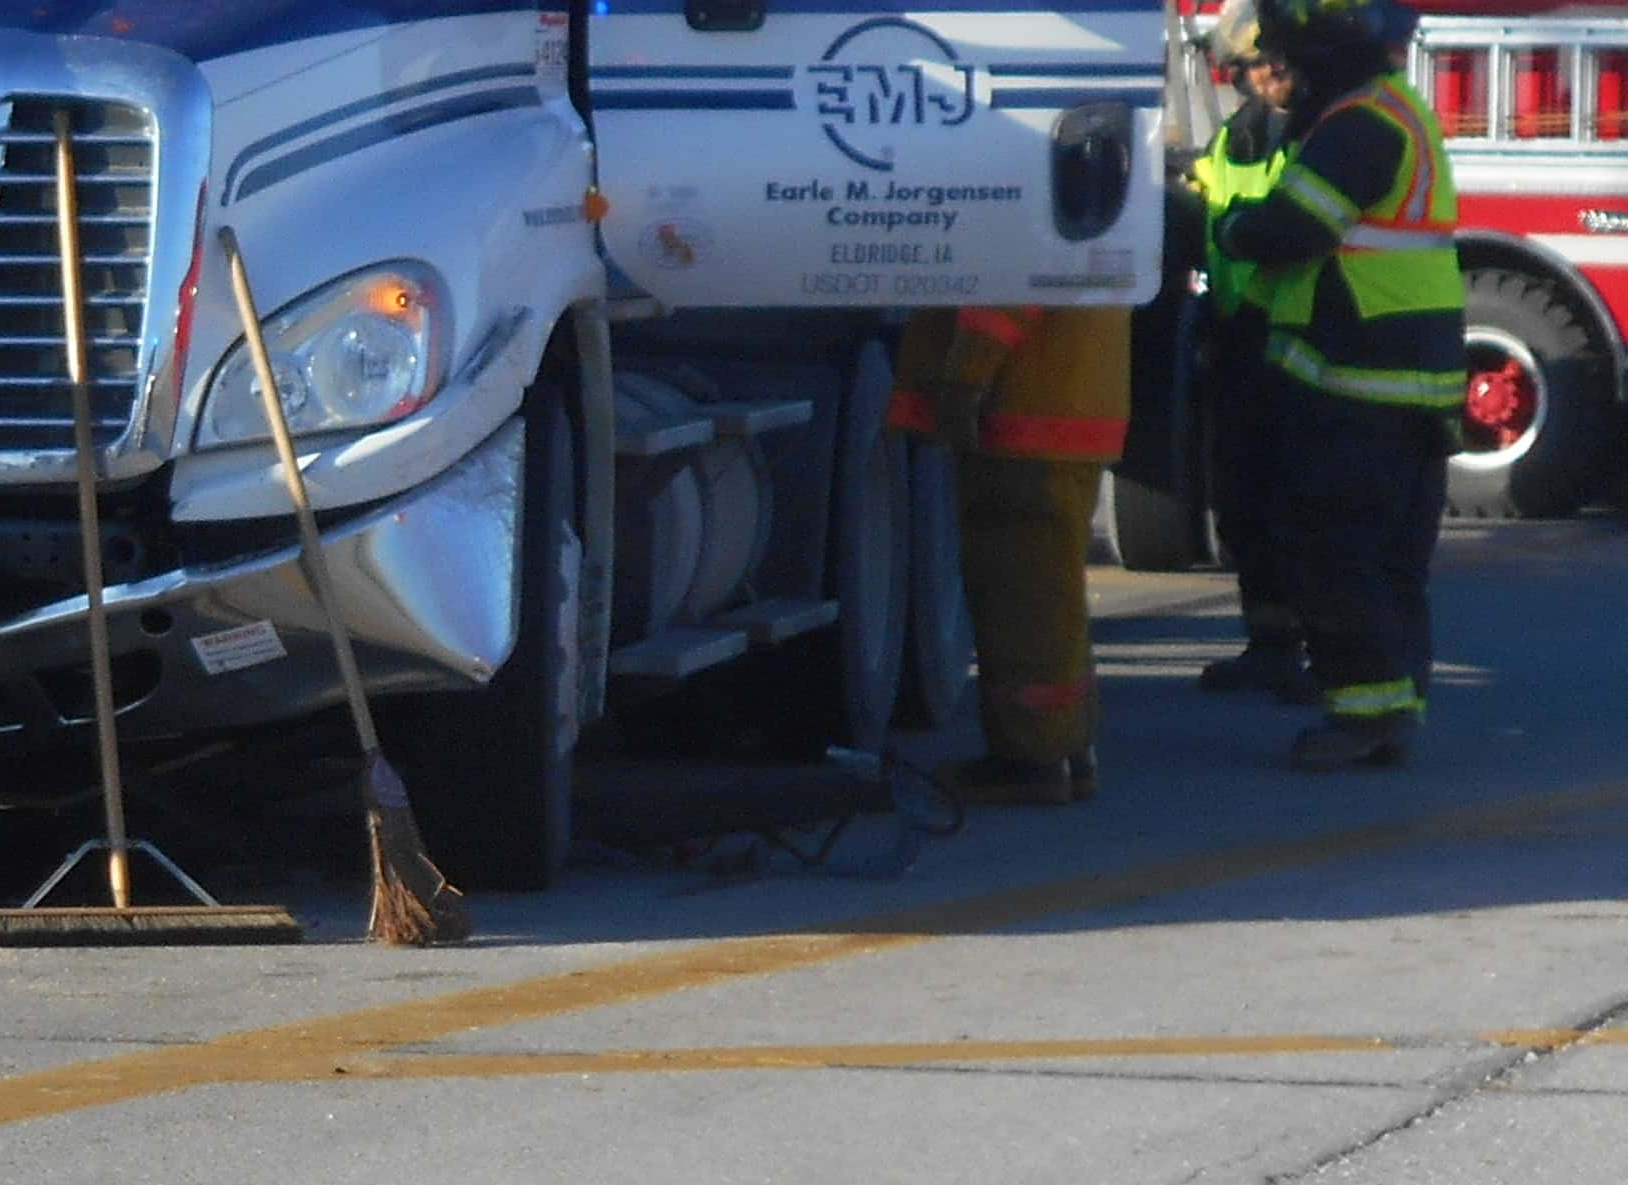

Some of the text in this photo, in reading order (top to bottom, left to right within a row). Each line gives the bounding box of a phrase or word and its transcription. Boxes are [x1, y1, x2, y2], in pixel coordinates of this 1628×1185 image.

[807, 65, 975, 126] EMJ
[765, 179, 1022, 206] Earle M. Jorgensen
[826, 206, 959, 232] Company
[935, 244, 953, 264] IA
[801, 272, 882, 295] USDOT
